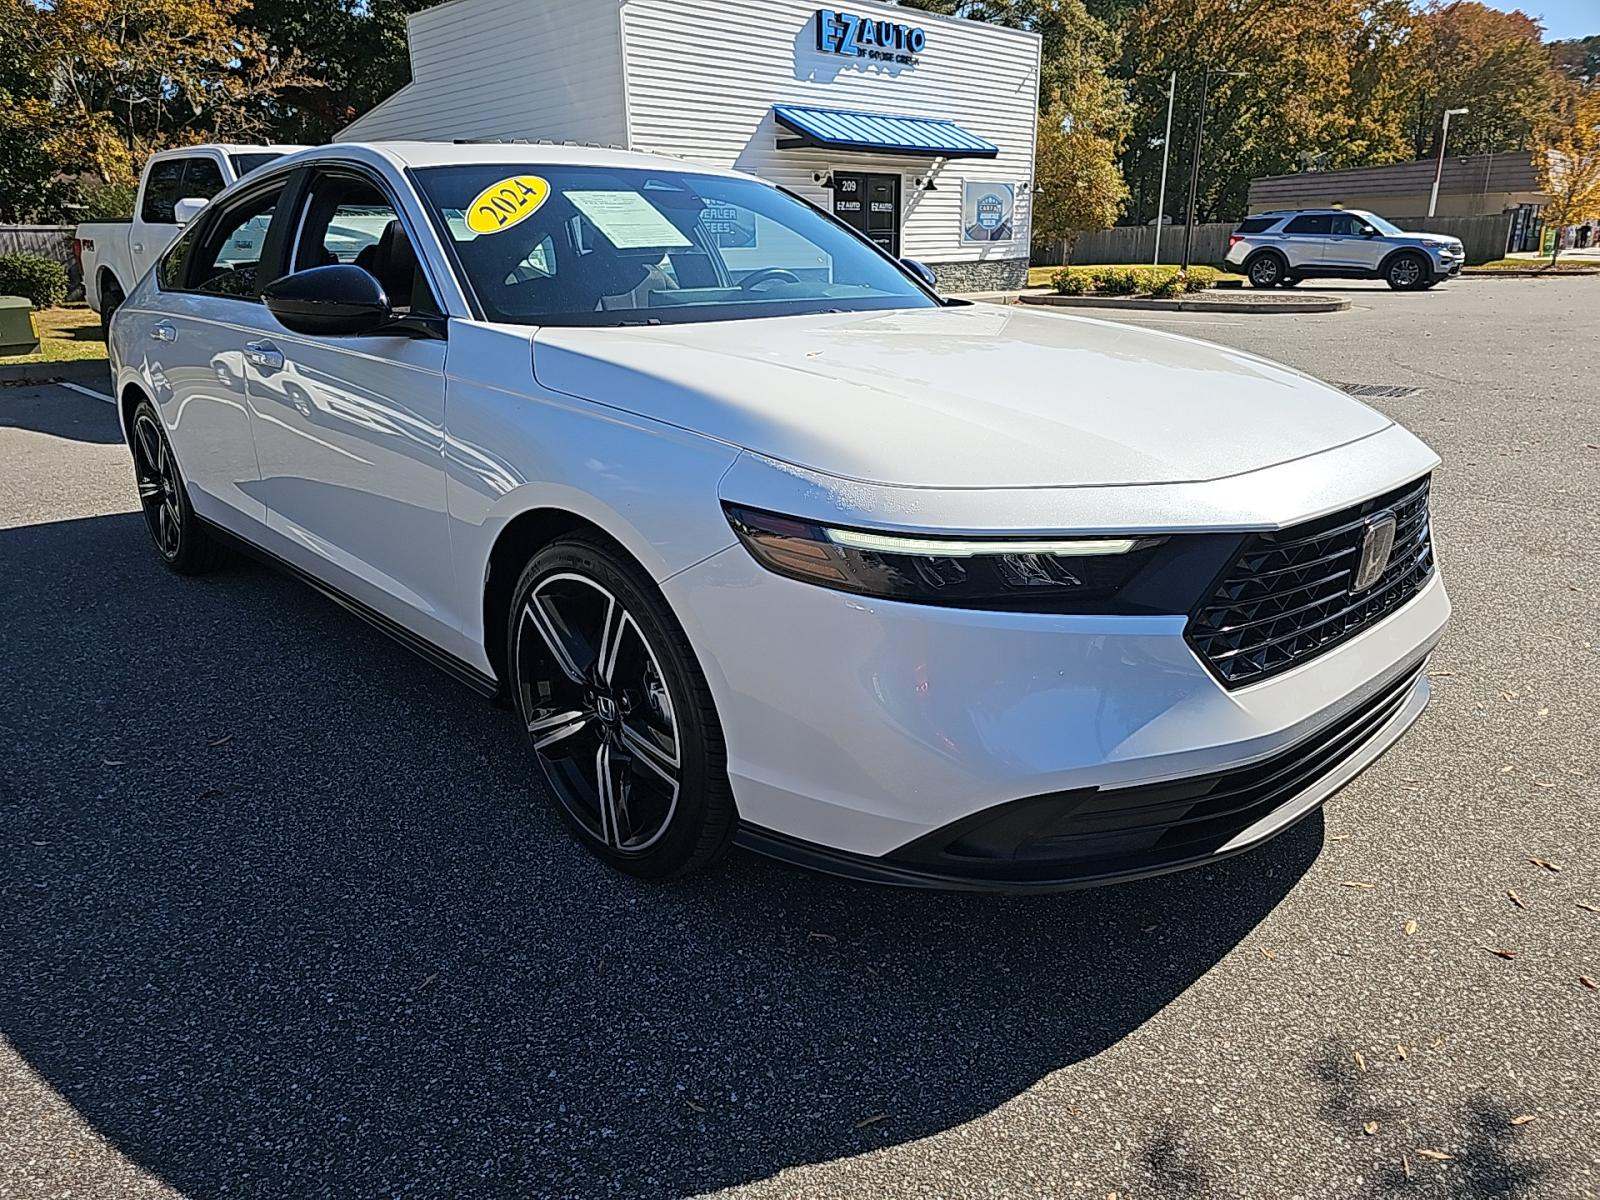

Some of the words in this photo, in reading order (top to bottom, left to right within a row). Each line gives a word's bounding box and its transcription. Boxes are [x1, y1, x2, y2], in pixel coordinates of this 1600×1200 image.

[857, 18, 925, 52] AUTO
[842, 181, 856, 191] 209
[479, 180, 537, 225] 2024
[703, 209, 737, 219] EALER
